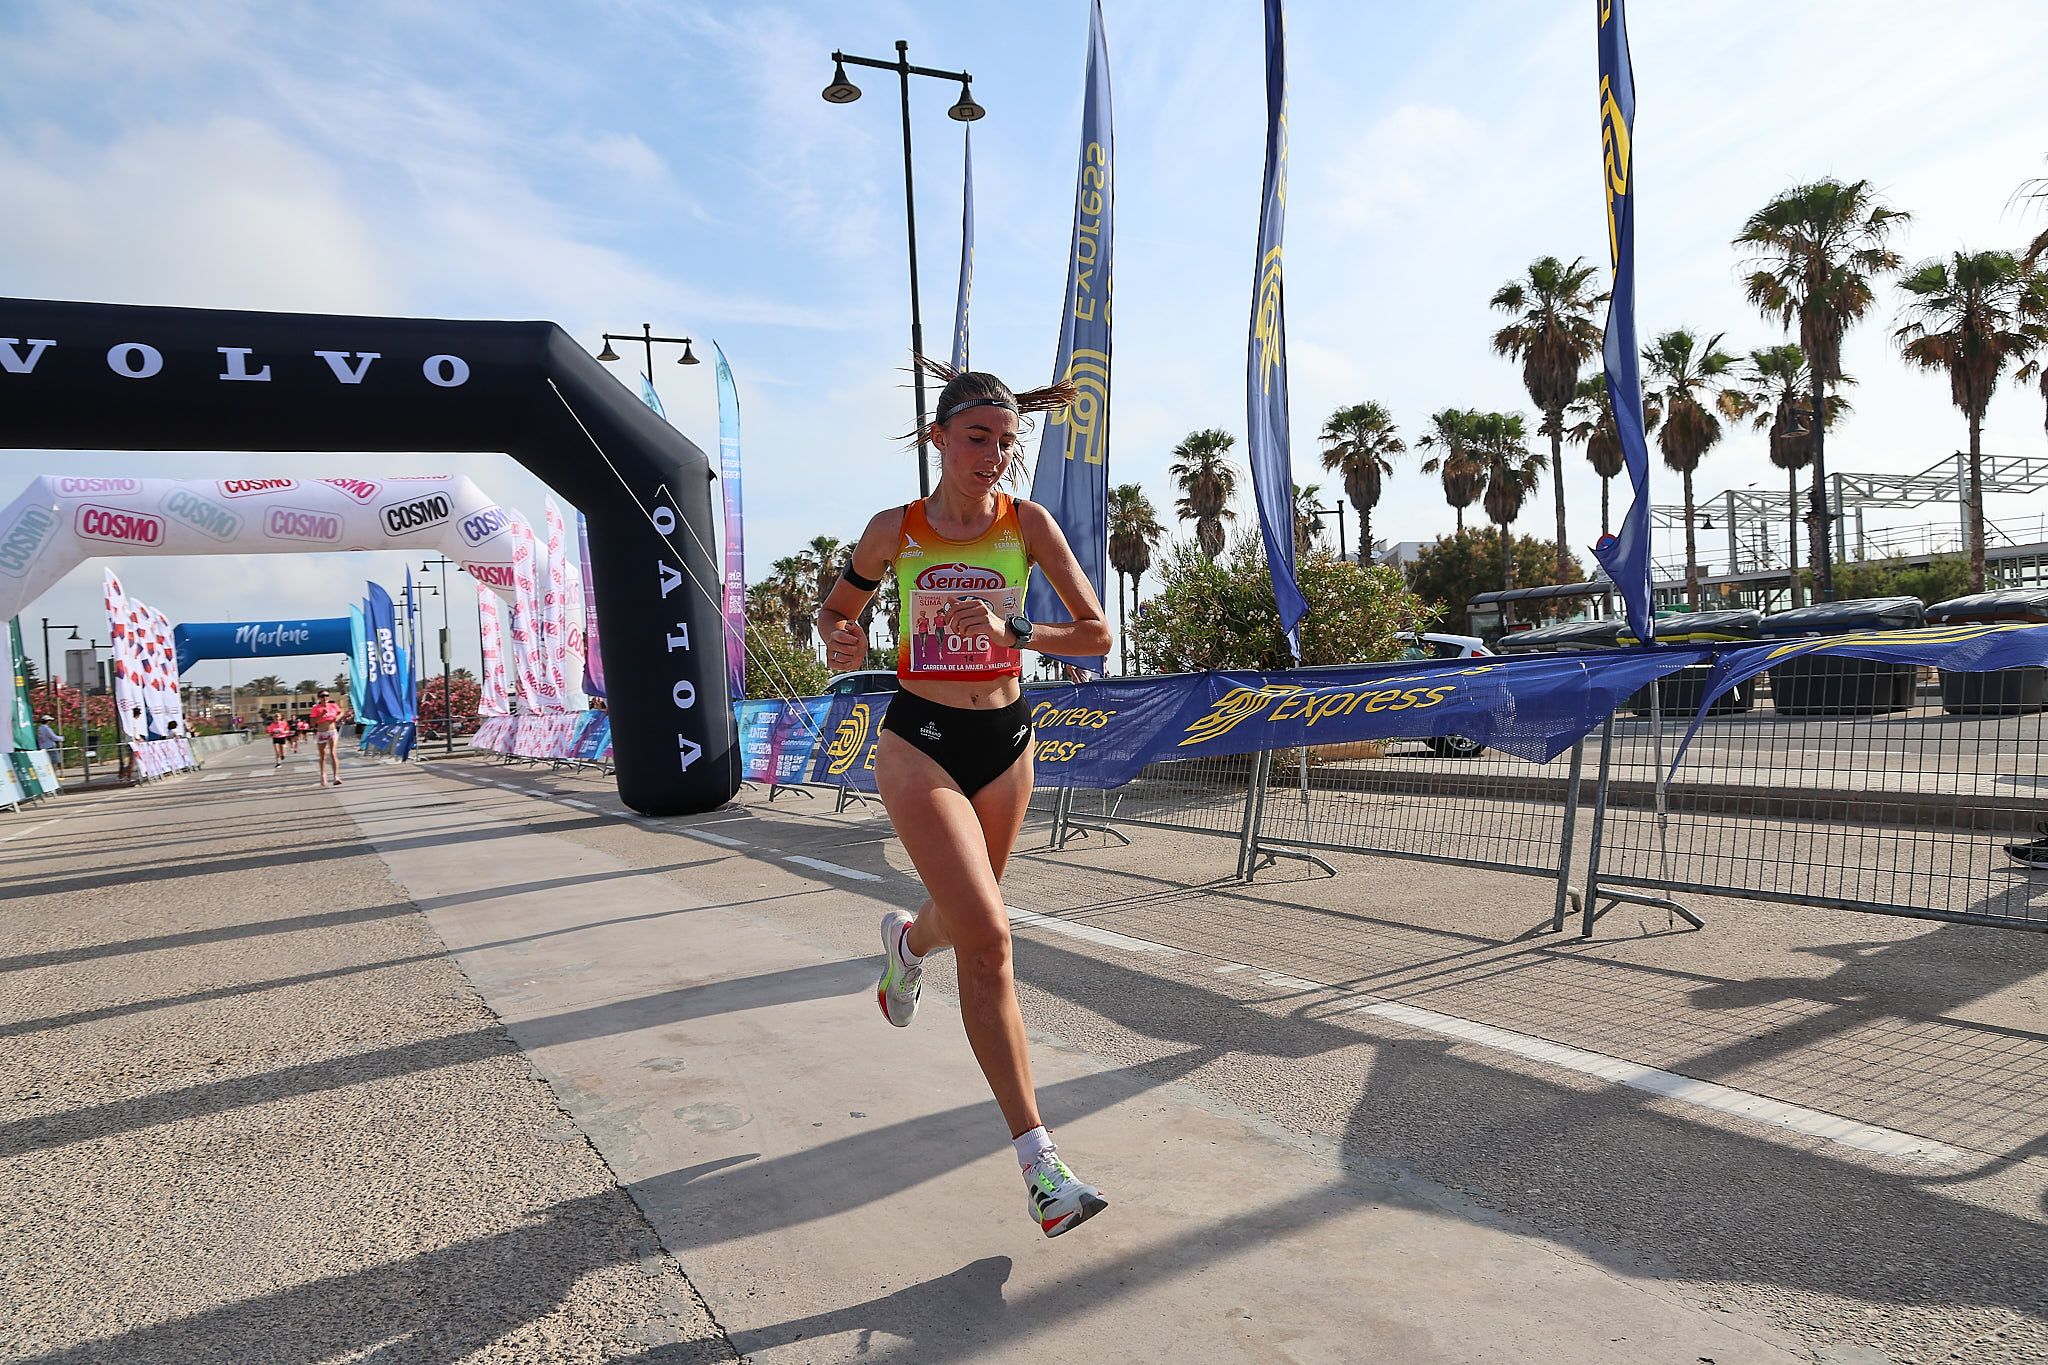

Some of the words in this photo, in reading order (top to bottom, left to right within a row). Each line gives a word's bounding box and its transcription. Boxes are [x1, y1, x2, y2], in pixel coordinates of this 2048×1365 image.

[0, 337, 471, 388] VOLVO
[83, 509, 158, 543] COSMO
[167, 491, 237, 538] COSMO
[271, 510, 338, 539] COSMO
[387, 496, 449, 532] COSMO
[463, 508, 512, 541] COSM
[0, 510, 54, 571] COSMO
[468, 564, 514, 586] COSM
[925, 572, 999, 589] Serrano
[652, 504, 703, 773] VOLVO
[947, 634, 990, 652] 016
[965, 663, 984, 671] MUJER
[988, 661, 1011, 670] VALENCIA
[1031, 701, 1116, 729] Correos
[1268, 684, 1457, 727] Express
[1034, 740, 1086, 762] ress
